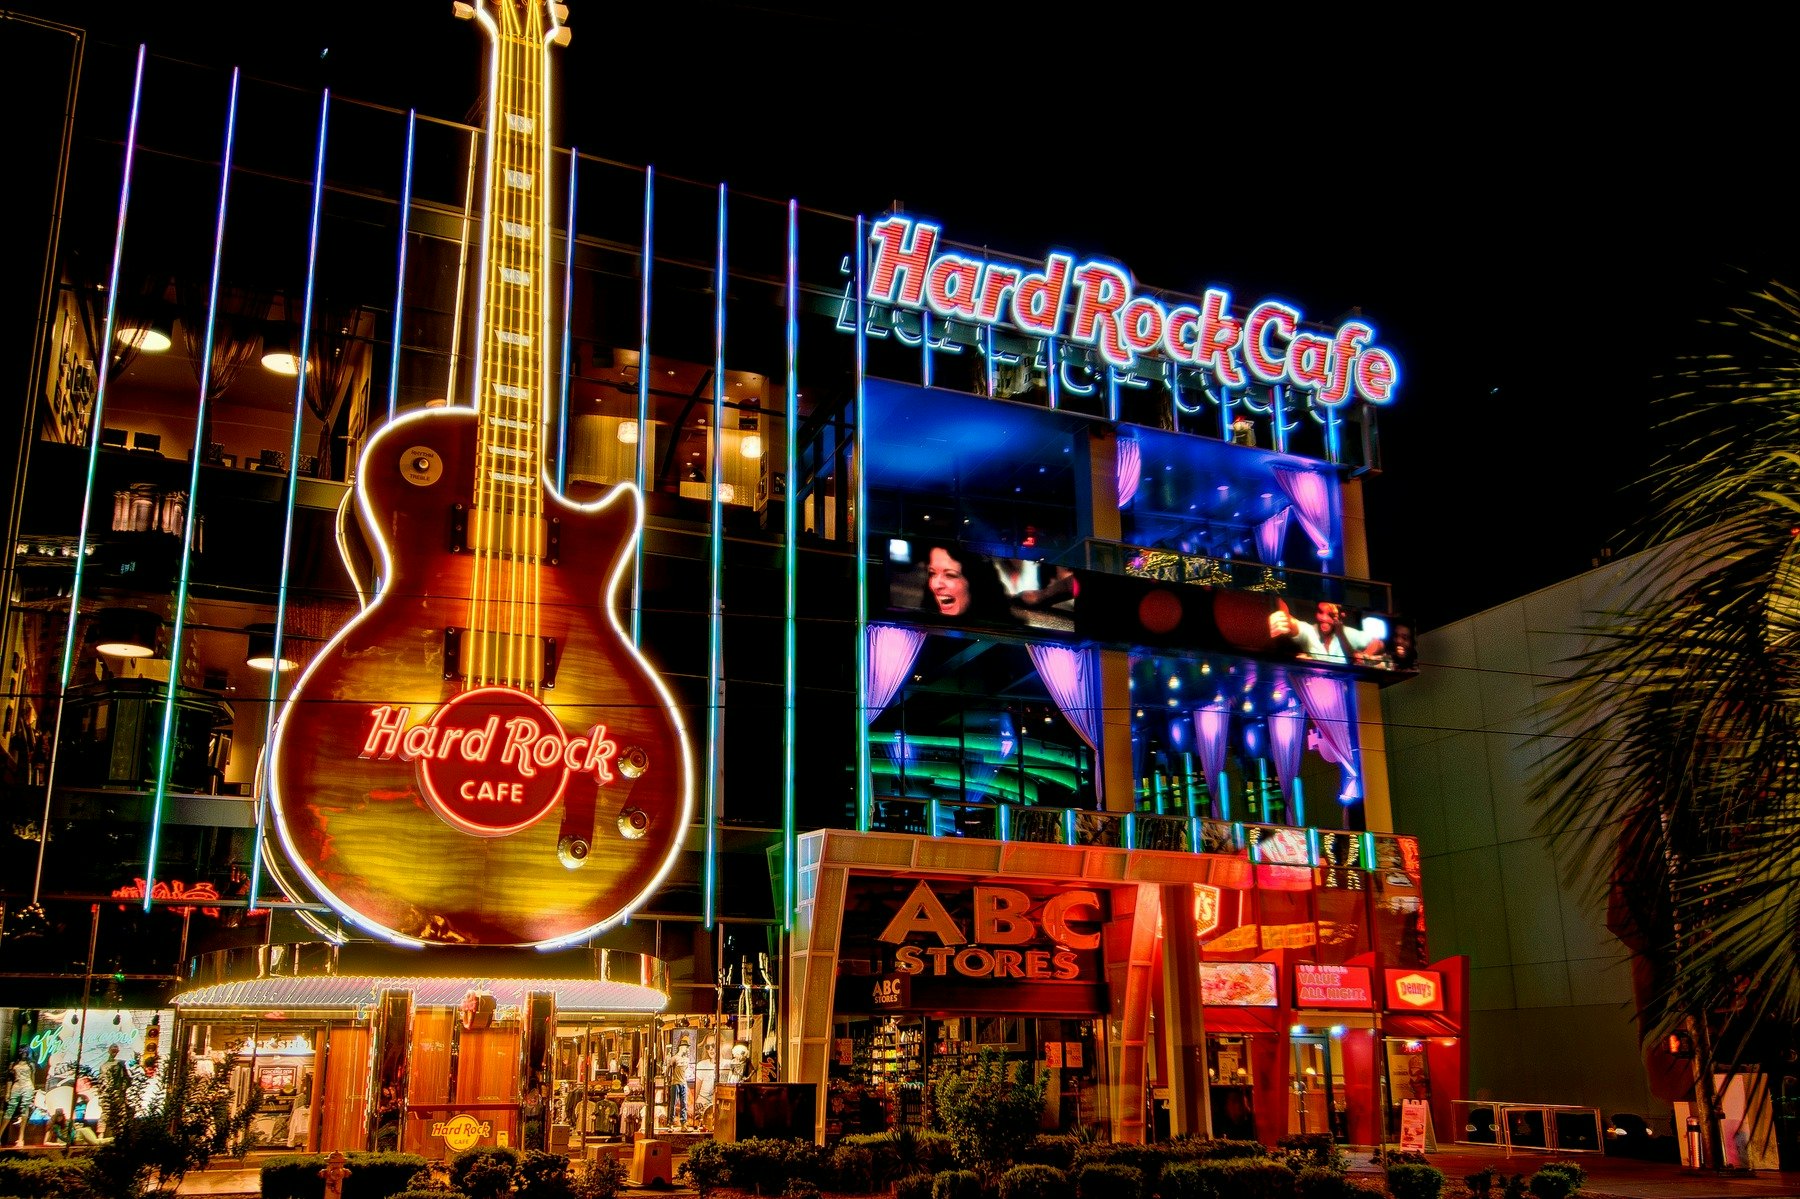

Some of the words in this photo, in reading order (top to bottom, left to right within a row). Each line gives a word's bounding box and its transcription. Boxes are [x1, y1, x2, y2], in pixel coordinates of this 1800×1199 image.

[868, 216, 1073, 334] Hard
[1073, 260, 1245, 386] Rock
[1244, 301, 1398, 405] Cafe
[362, 704, 500, 763] Hard
[501, 715, 618, 782] Rock
[460, 781, 525, 804] CAFE
[876, 878, 1101, 950] ABC
[895, 945, 1080, 980] STORES
[872, 978, 901, 996] ABC
[1299, 972, 1341, 987] VALUE
[1300, 986, 1326, 1001] ALL
[1400, 981, 1432, 998] Denny's
[874, 994, 898, 1004] STORES
[431, 1122, 462, 1137] Hard
[463, 1121, 491, 1138] Rock
